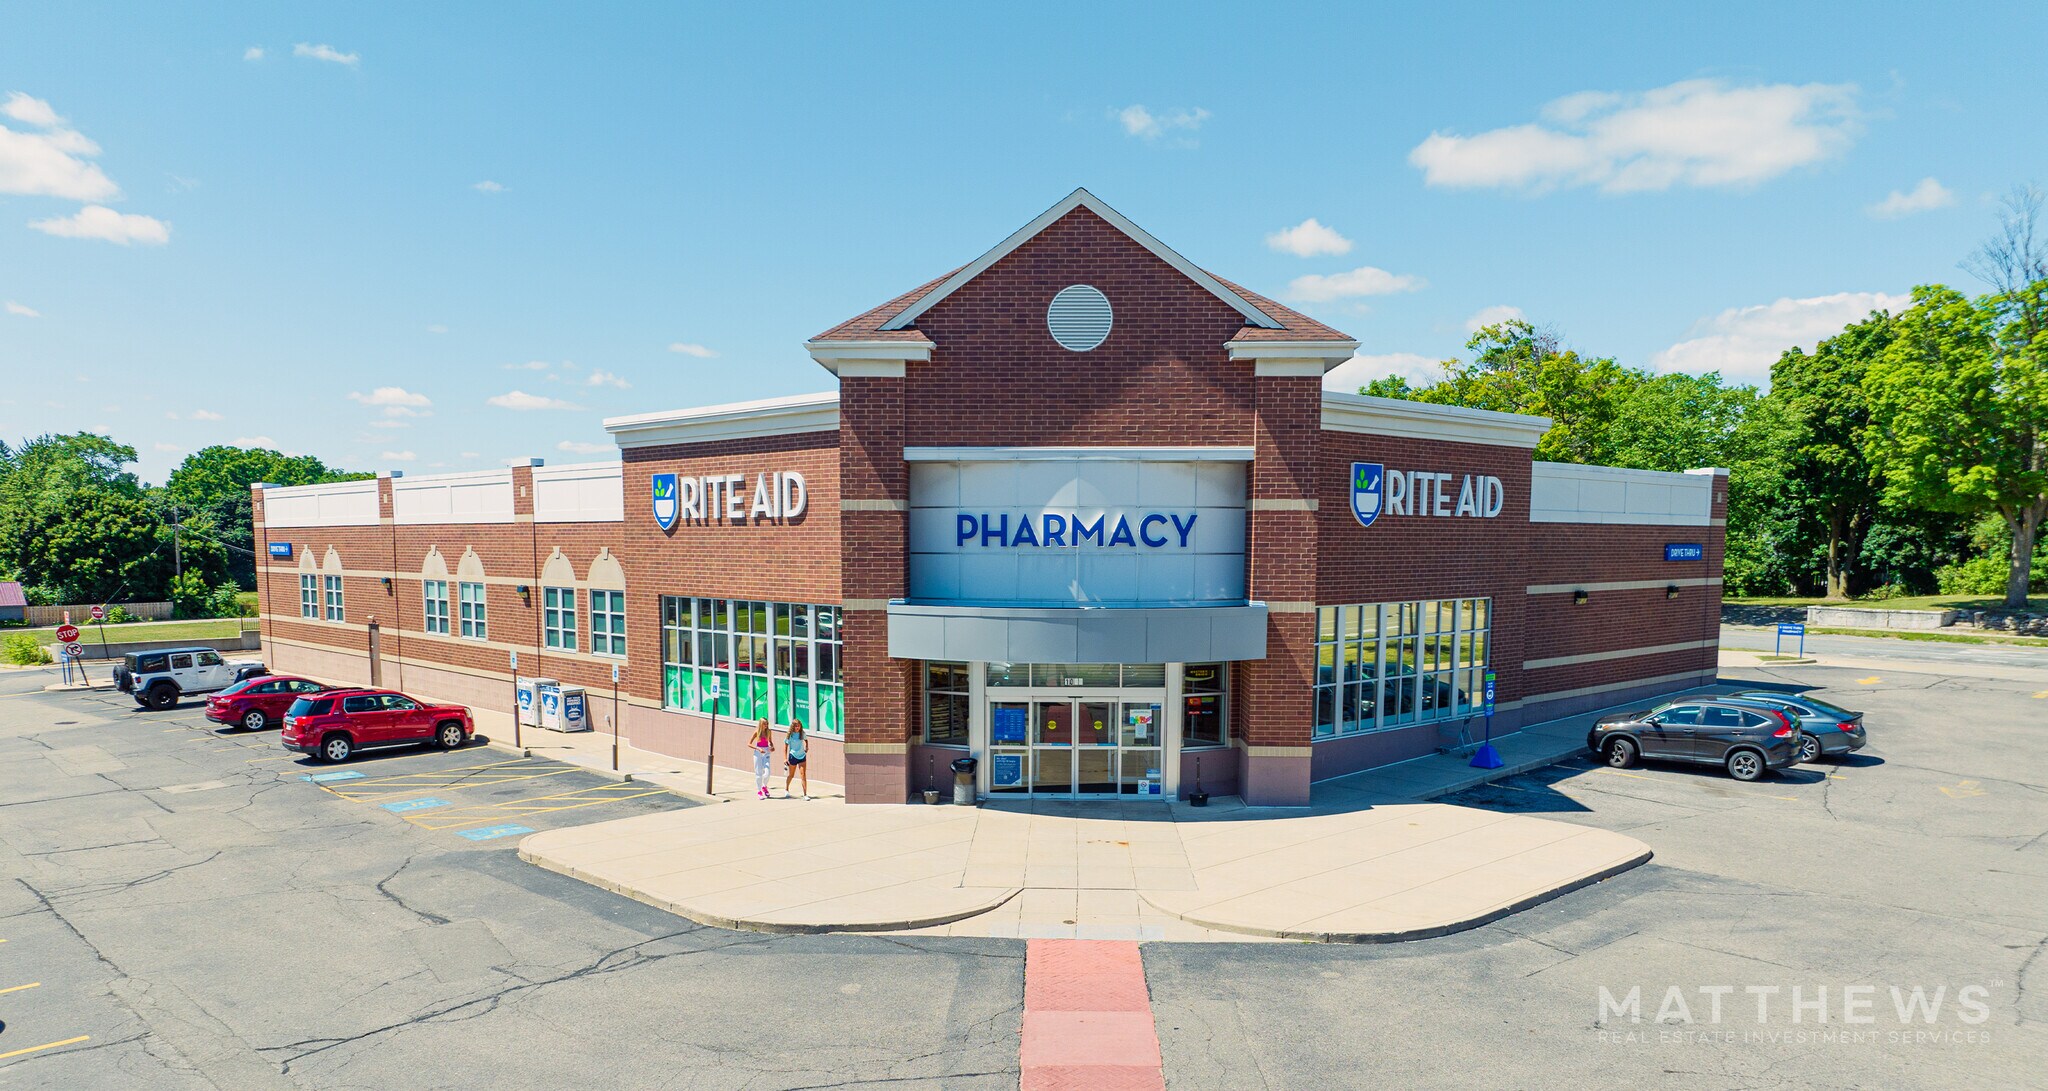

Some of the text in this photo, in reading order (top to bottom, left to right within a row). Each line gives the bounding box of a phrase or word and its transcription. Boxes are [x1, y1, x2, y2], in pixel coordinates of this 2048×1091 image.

[680, 471, 806, 519] RITE AID
[1385, 470, 1504, 518] RITE AID
[956, 514, 1198, 548] PHARMACY
[1671, 548, 1696, 557] DRIVE THRU
[57, 628, 78, 640] STOP
